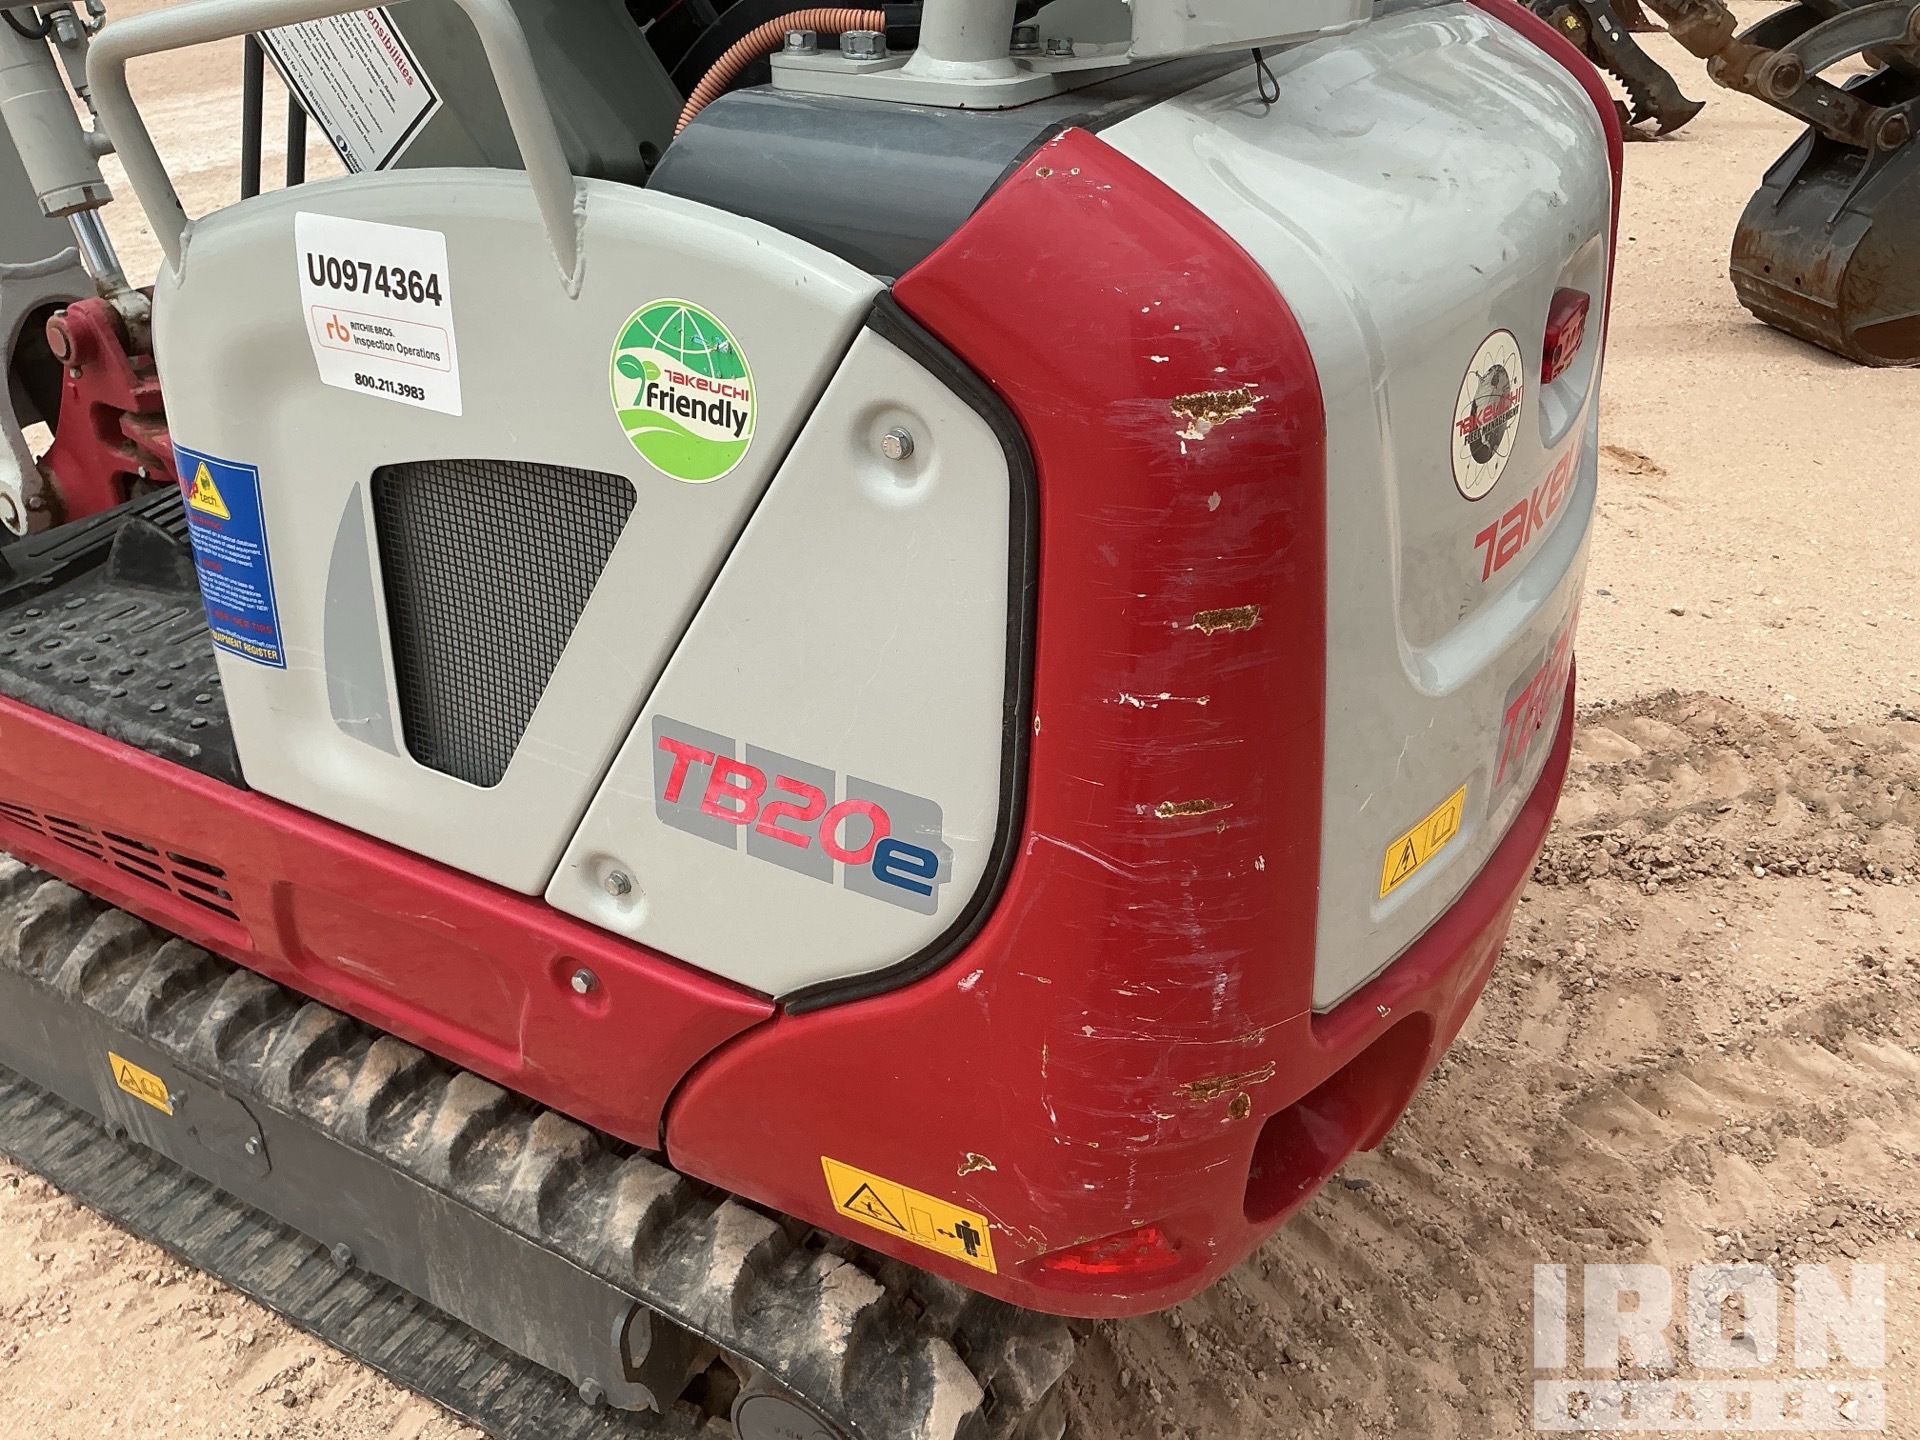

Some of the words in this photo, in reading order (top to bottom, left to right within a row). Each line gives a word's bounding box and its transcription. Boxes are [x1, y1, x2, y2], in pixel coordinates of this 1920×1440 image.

[279, 44, 290, 61] You
[289, 60, 297, 72] for
[296, 71, 309, 90] Your
[308, 89, 332, 126] Business!
[307, 252, 442, 306] U0974364
[325, 314, 351, 342] rb
[350, 321, 375, 334] RITCHIE
[353, 334, 395, 352] Inspection
[396, 342, 441, 361] Operations
[354, 372, 425, 401] 800.211.3983
[663, 369, 750, 402] TAKEUCHI
[646, 382, 748, 438] friendly
[1481, 404, 1519, 437] MANAGEMENT
[244, 639, 278, 660] REGISTER
